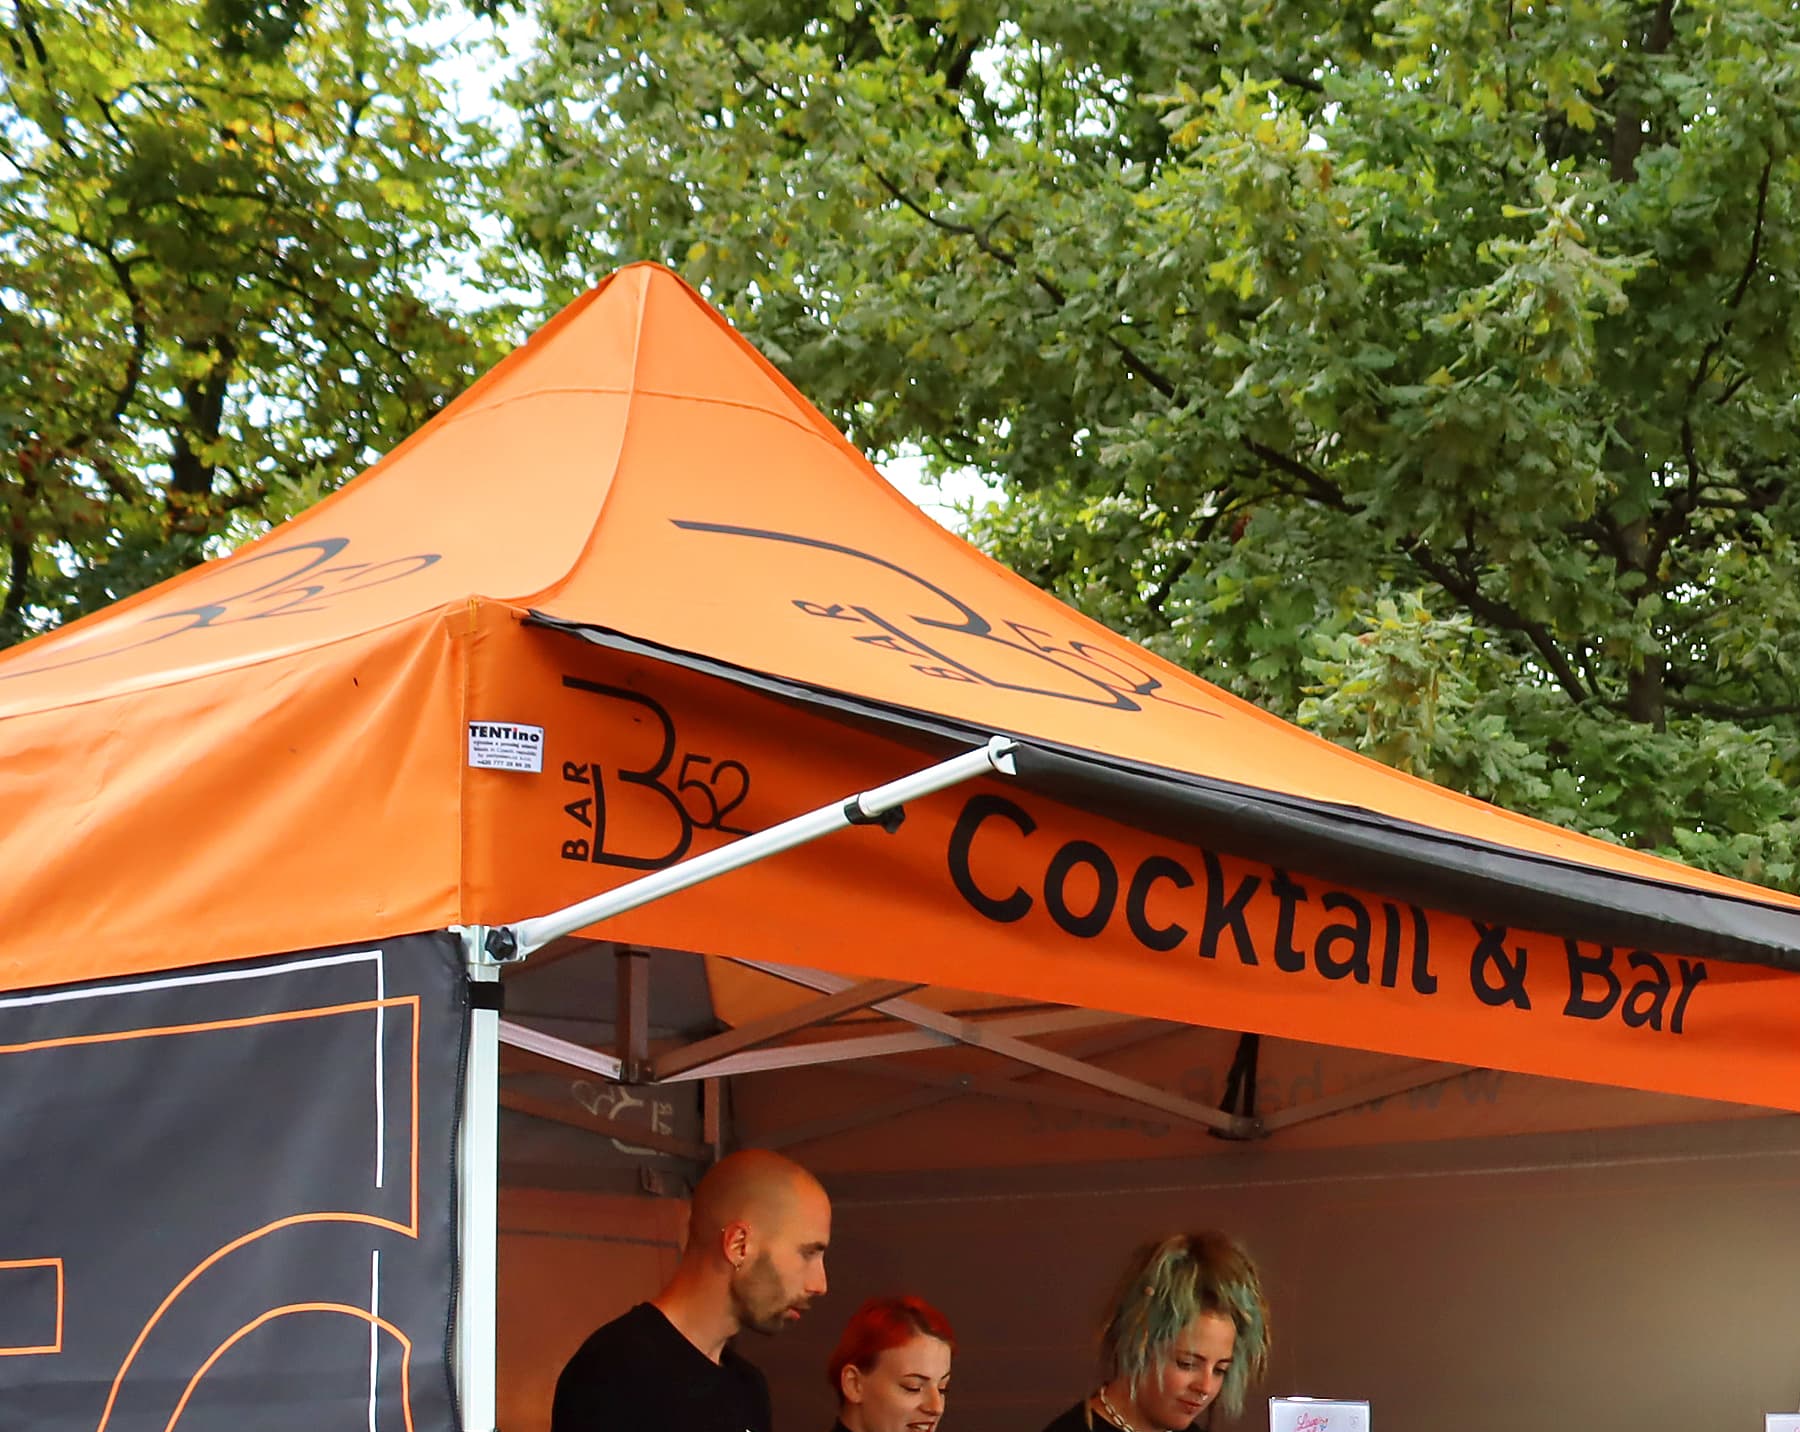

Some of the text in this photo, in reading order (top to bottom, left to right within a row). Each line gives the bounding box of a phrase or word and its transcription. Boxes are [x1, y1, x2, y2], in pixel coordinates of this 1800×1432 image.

[469, 725, 540, 742] TENTino
[561, 761, 592, 863] BAR
[946, 793, 1708, 1036] Cocktail & Bar
